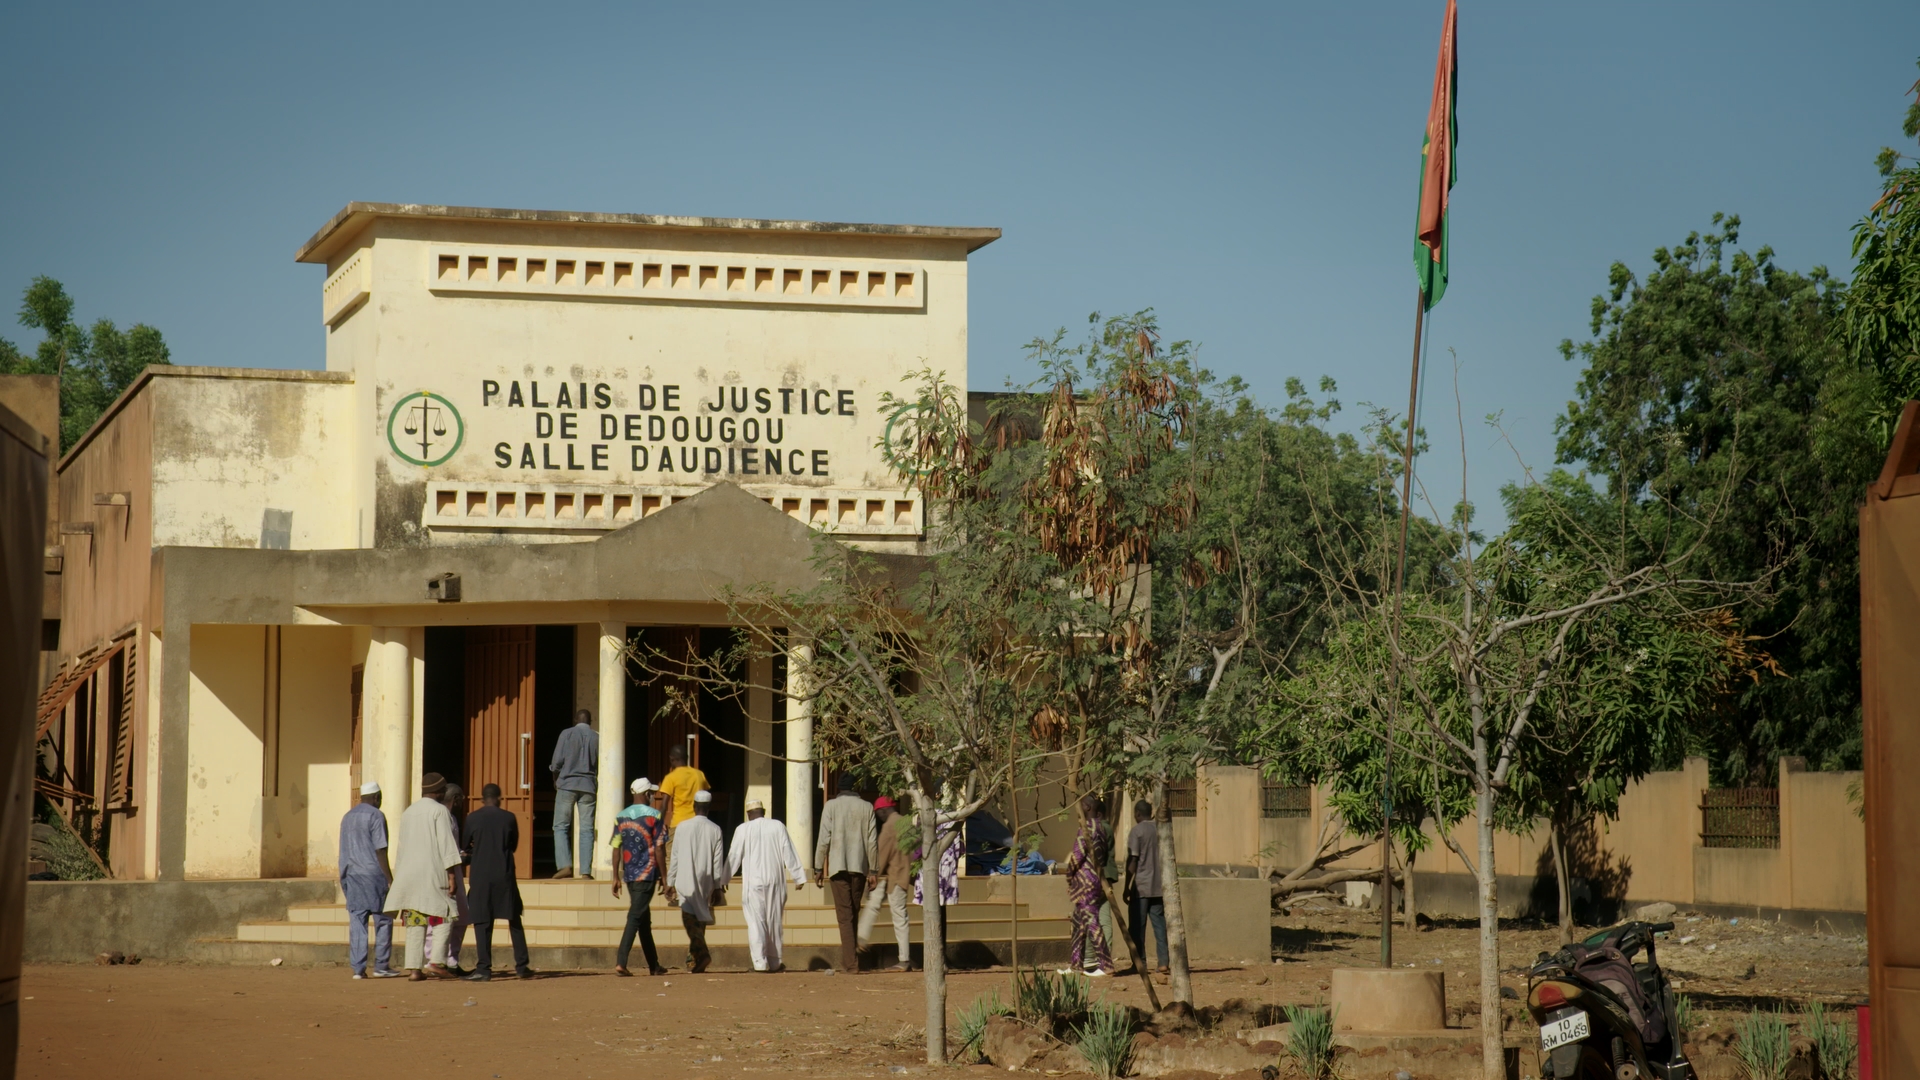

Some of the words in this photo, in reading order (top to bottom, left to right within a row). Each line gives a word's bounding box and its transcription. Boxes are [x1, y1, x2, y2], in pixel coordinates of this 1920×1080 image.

[482, 380, 612, 409] PALAIS
[639, 384, 680, 412] DE
[708, 386, 855, 416] JUSTICE
[536, 412, 578, 439] DE
[600, 414, 783, 444] DEDOUGOU
[494, 442, 609, 470] SALLE
[631, 445, 829, 476] D'AUDIENCE
[1542, 1035, 1558, 1049] RM
[1560, 1024, 1588, 1042] 0469
[1558, 1019, 1571, 1032] 10
